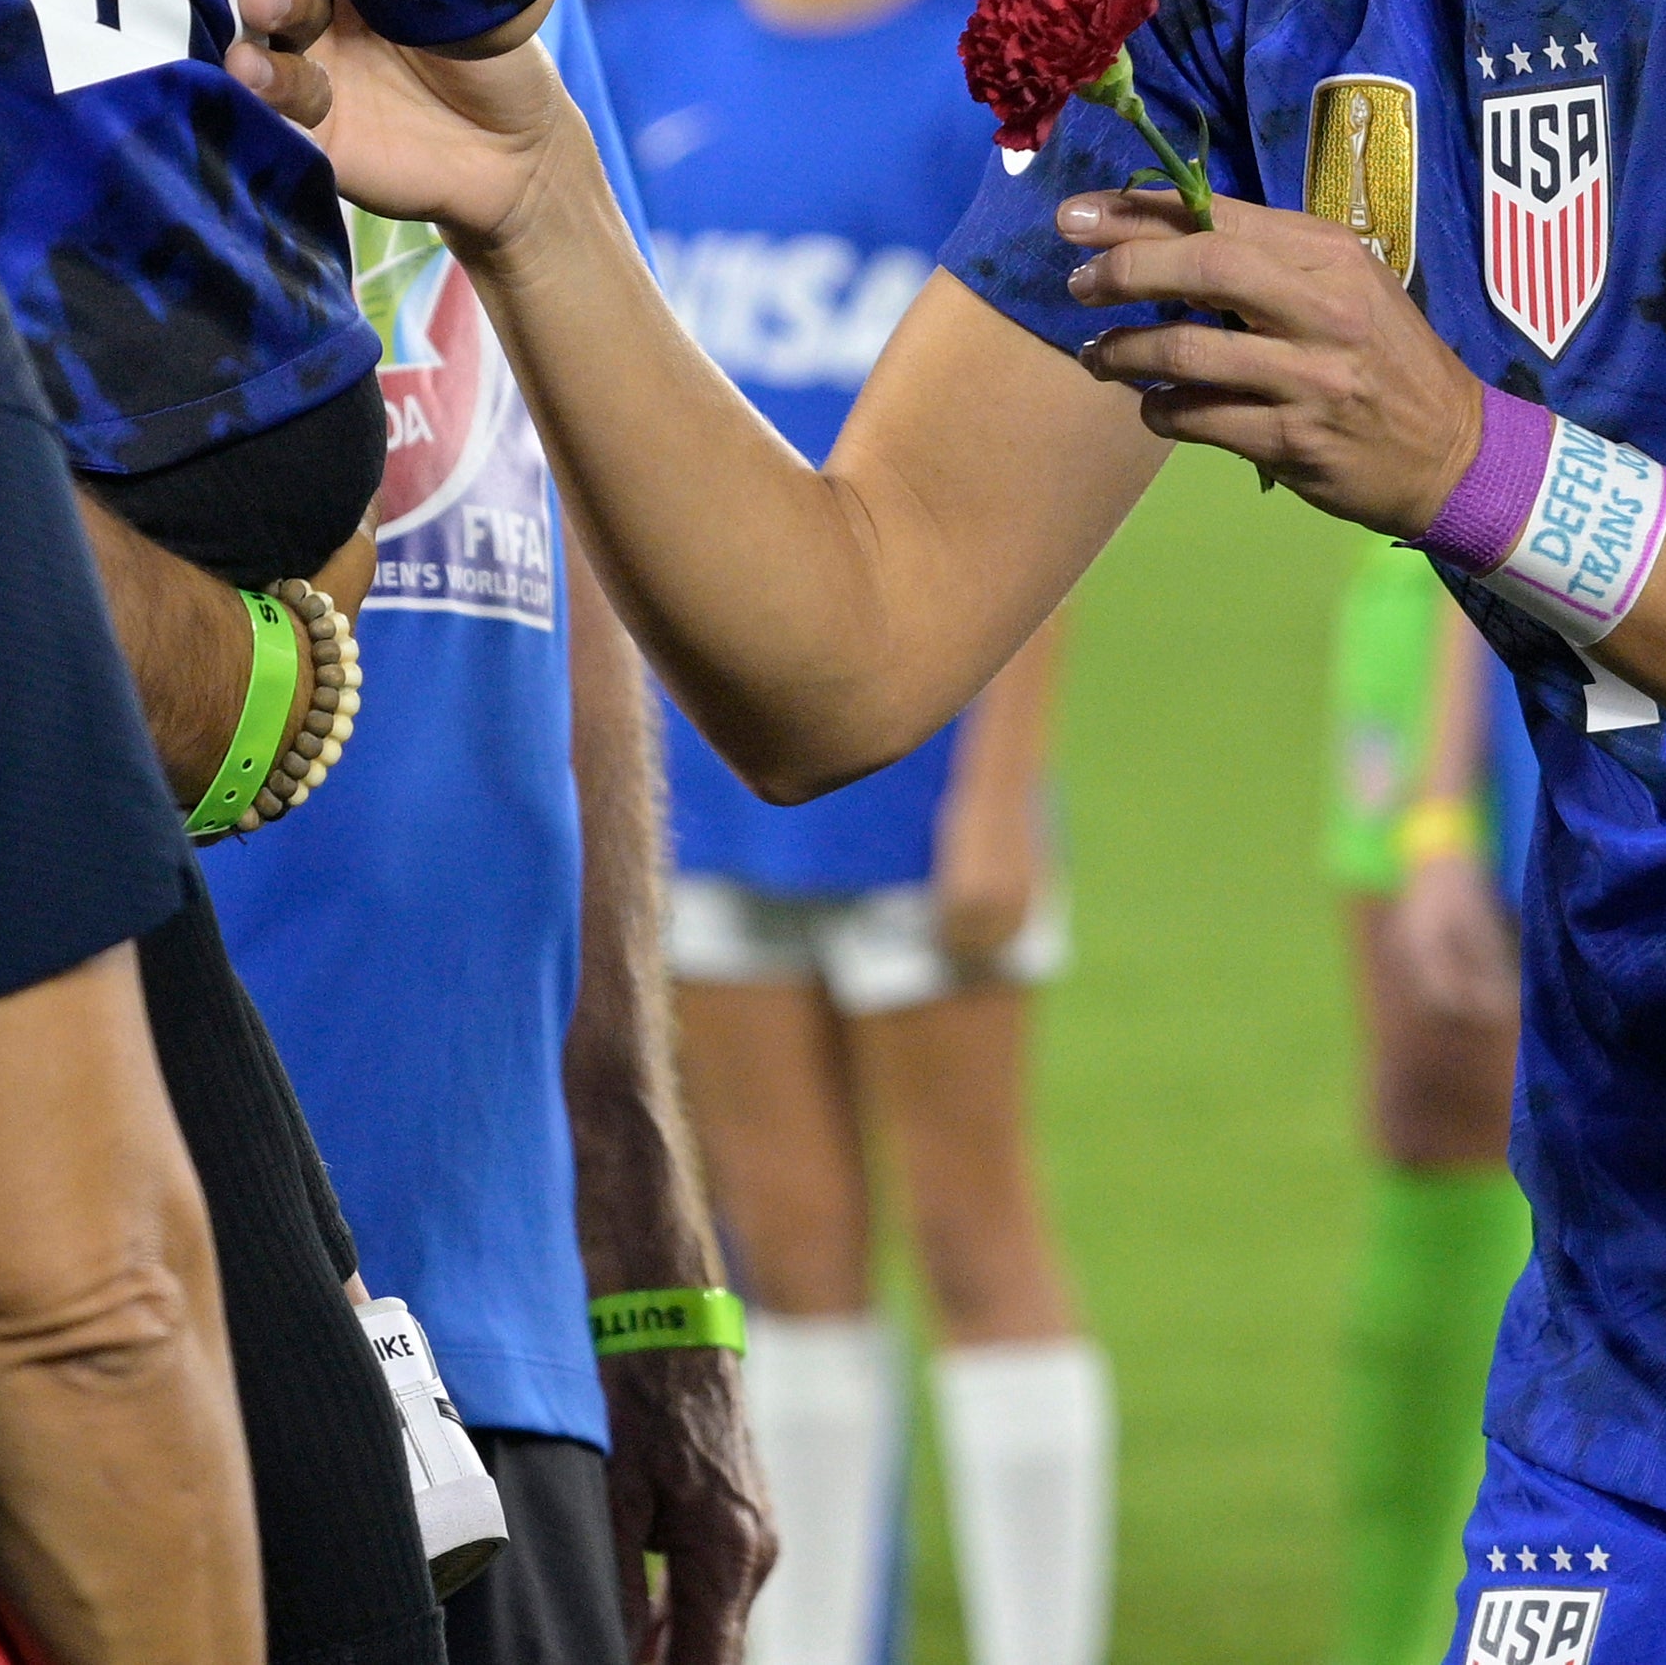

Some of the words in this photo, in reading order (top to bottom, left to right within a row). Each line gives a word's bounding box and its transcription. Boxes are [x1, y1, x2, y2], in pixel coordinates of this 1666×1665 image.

[1491, 98, 1599, 204] USA
[462, 503, 546, 574] FIFA
[1567, 486, 1644, 599] TRANS
[446, 563, 518, 598] WORLD
[518, 576, 548, 605] CUP
[1478, 1600, 1591, 1665] USA
